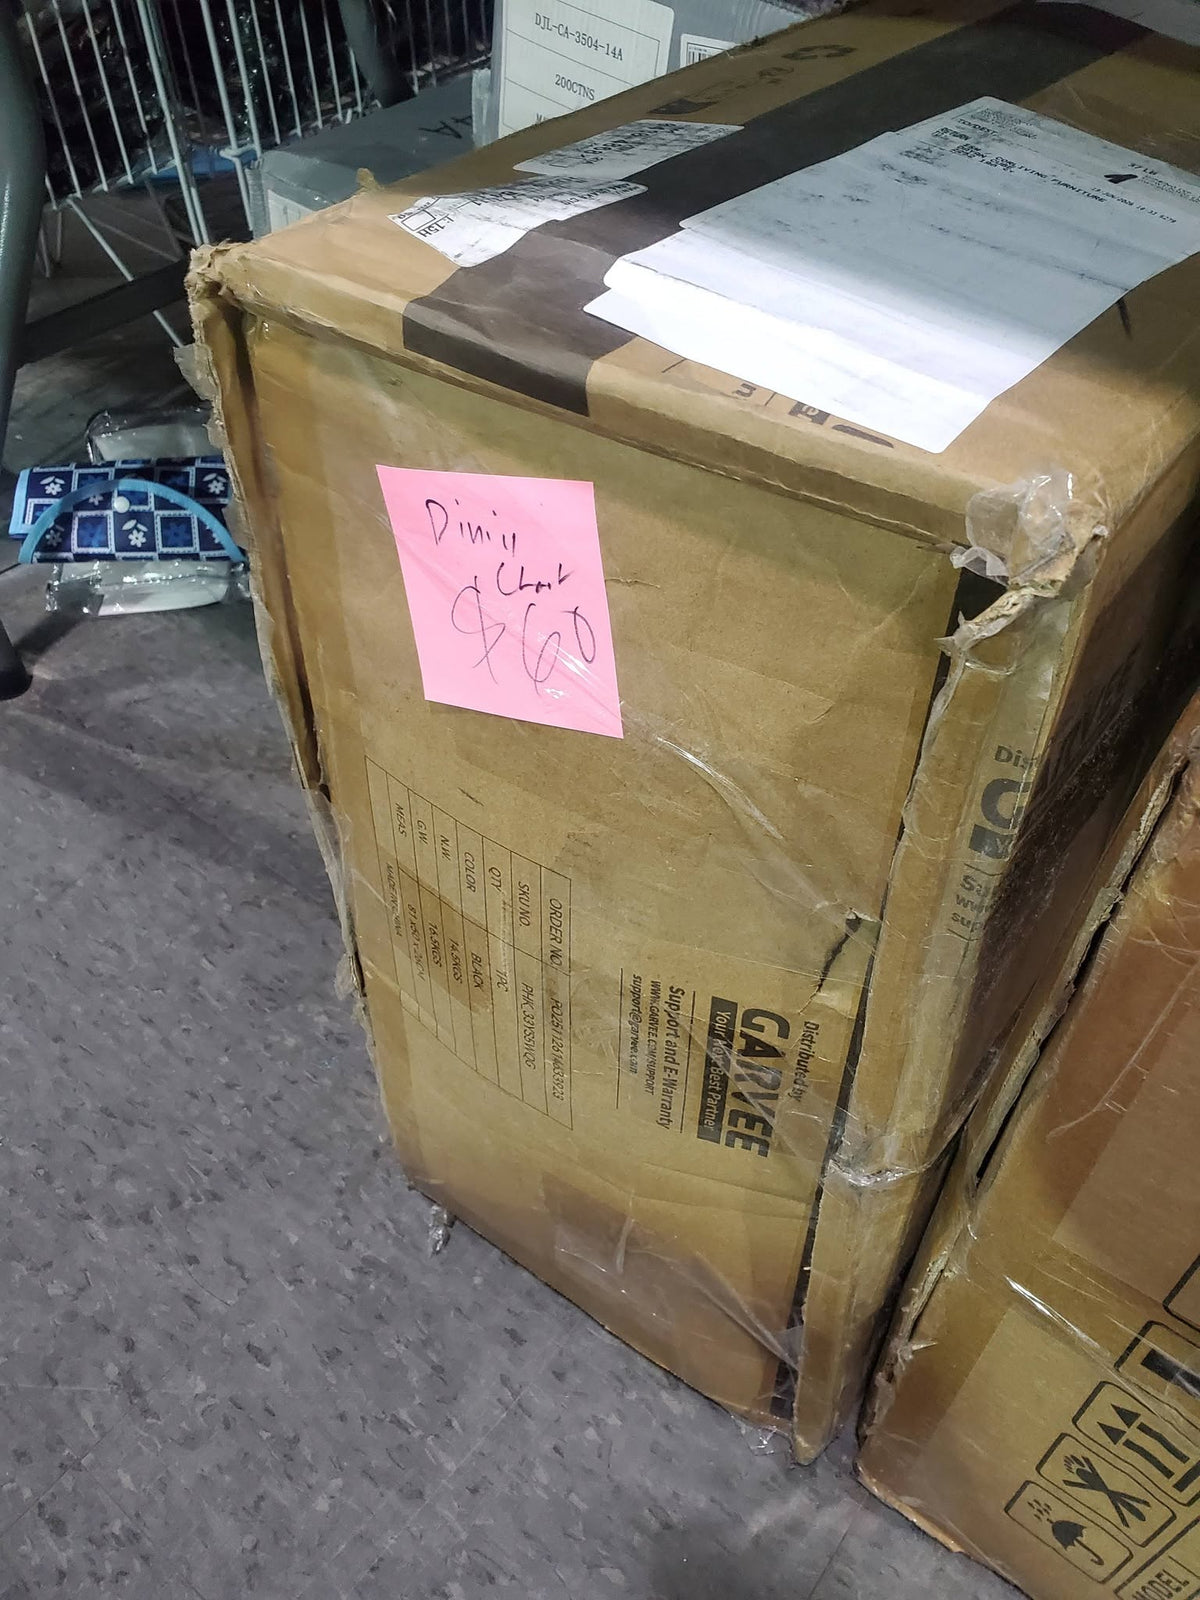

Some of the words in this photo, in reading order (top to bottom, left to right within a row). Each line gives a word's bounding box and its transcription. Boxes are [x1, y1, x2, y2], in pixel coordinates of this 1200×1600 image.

[534, 12, 623, 61] DJL-CA-3504-14A
[555, 73, 595, 101] 200CTNS
[1050, 178, 1107, 203] FURNITURE
[395, 803, 406, 837] MEAS
[519, 881, 530, 906] SKU
[464, 852, 476, 892] COLOR
[471, 952, 484, 990] BLACK
[489, 867, 502, 892] QTY
[496, 969, 508, 992] 1PC
[519, 907, 531, 927] NO.
[549, 899, 562, 941] ORDER
[428, 921, 442, 967] 16.5KGS
[449, 939, 463, 984] 14.5KGS
[663, 986, 685, 1039] Support
[714, 1011, 731, 1036] Your
[664, 1040, 679, 1065] and
[710, 1039, 726, 1064] Next
[793, 1021, 819, 1086] Distributed
[656, 1066, 678, 1129] E-Warranty
[708, 1068, 723, 1090] Best
[725, 1008, 791, 1158] GARVEE
[788, 1087, 804, 1102] by
[703, 1091, 720, 1131] Partner
